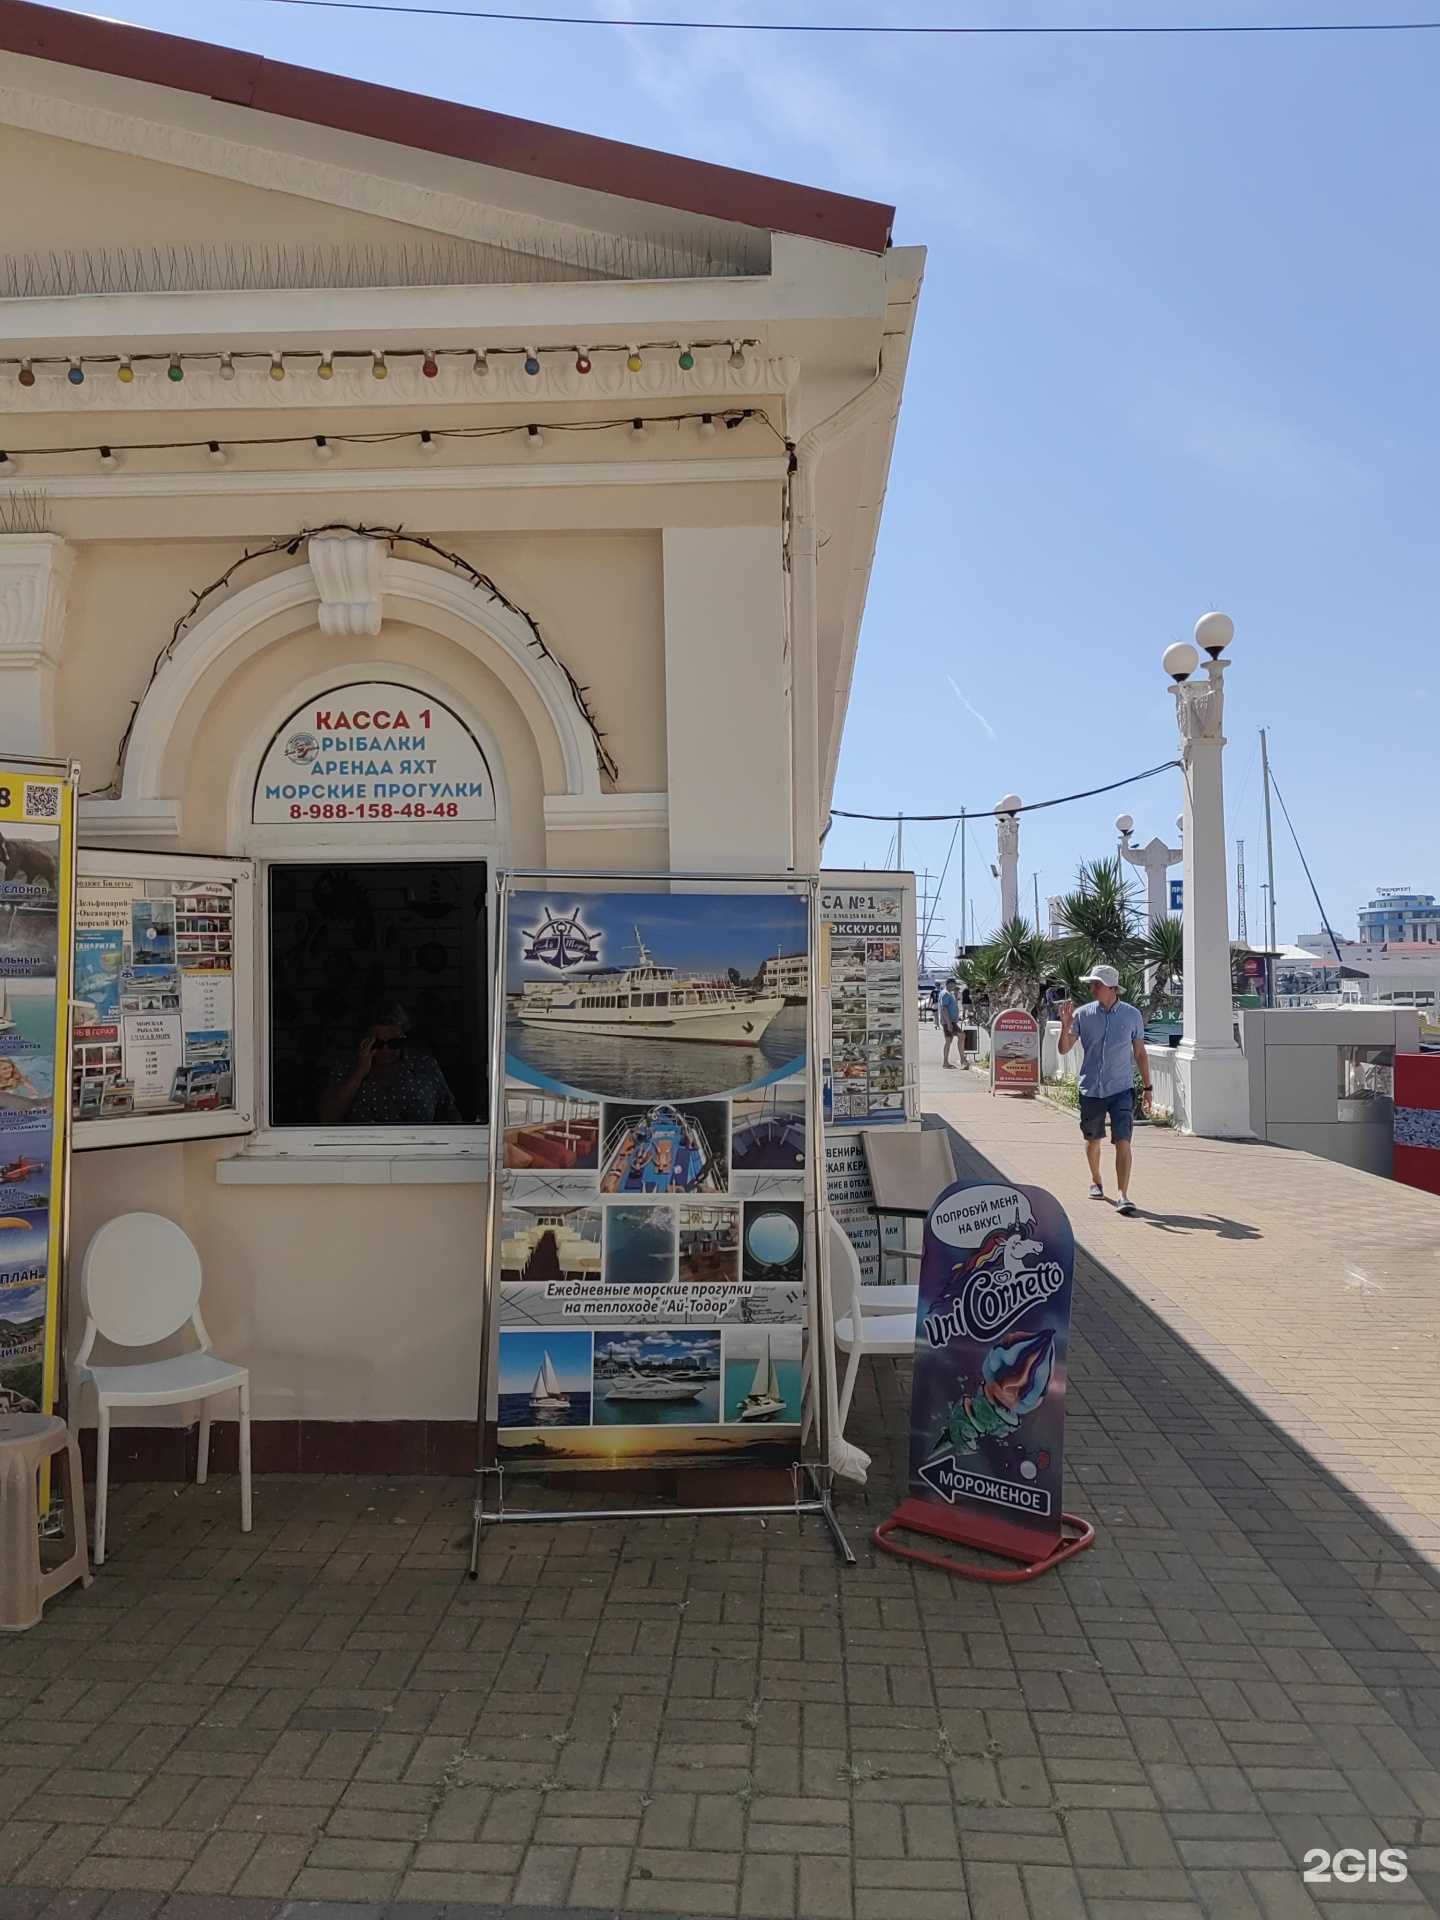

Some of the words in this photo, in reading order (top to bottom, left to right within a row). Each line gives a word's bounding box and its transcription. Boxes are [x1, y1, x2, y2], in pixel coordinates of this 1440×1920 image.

[315, 710, 410, 731] КАССА
[418, 709, 432, 729] 1
[321, 736, 426, 752] РЫБАЛКИ
[310, 760, 394, 776] АРЕНДА
[399, 759, 437, 775] ЯХТ
[265, 784, 367, 800] МОРСКИЕ
[374, 782, 482, 798] ПРОГУЛКИ
[289, 803, 459, 819] 8-988-158-48-48
[831, 924, 898, 934] ЭКСКУРСИИ
[825, 1162, 844, 1173] КАЯ
[828, 1191, 848, 1201] СНОЙ
[936, 1199, 989, 1226] ПОПРОБУЙ
[990, 1194, 1019, 1211] МЕНЯ
[958, 1223, 973, 1235] НА
[975, 1214, 1002, 1232] ВКУС!
[546, 1282, 630, 1297] Ежедневные
[632, 1284, 689, 1299] морские
[691, 1284, 752, 1299] прогулки
[564, 1302, 582, 1313] на
[584, 1300, 659, 1314] теплоходе
[939, 1470, 1041, 1510] МОРОЖЕНОЕ
